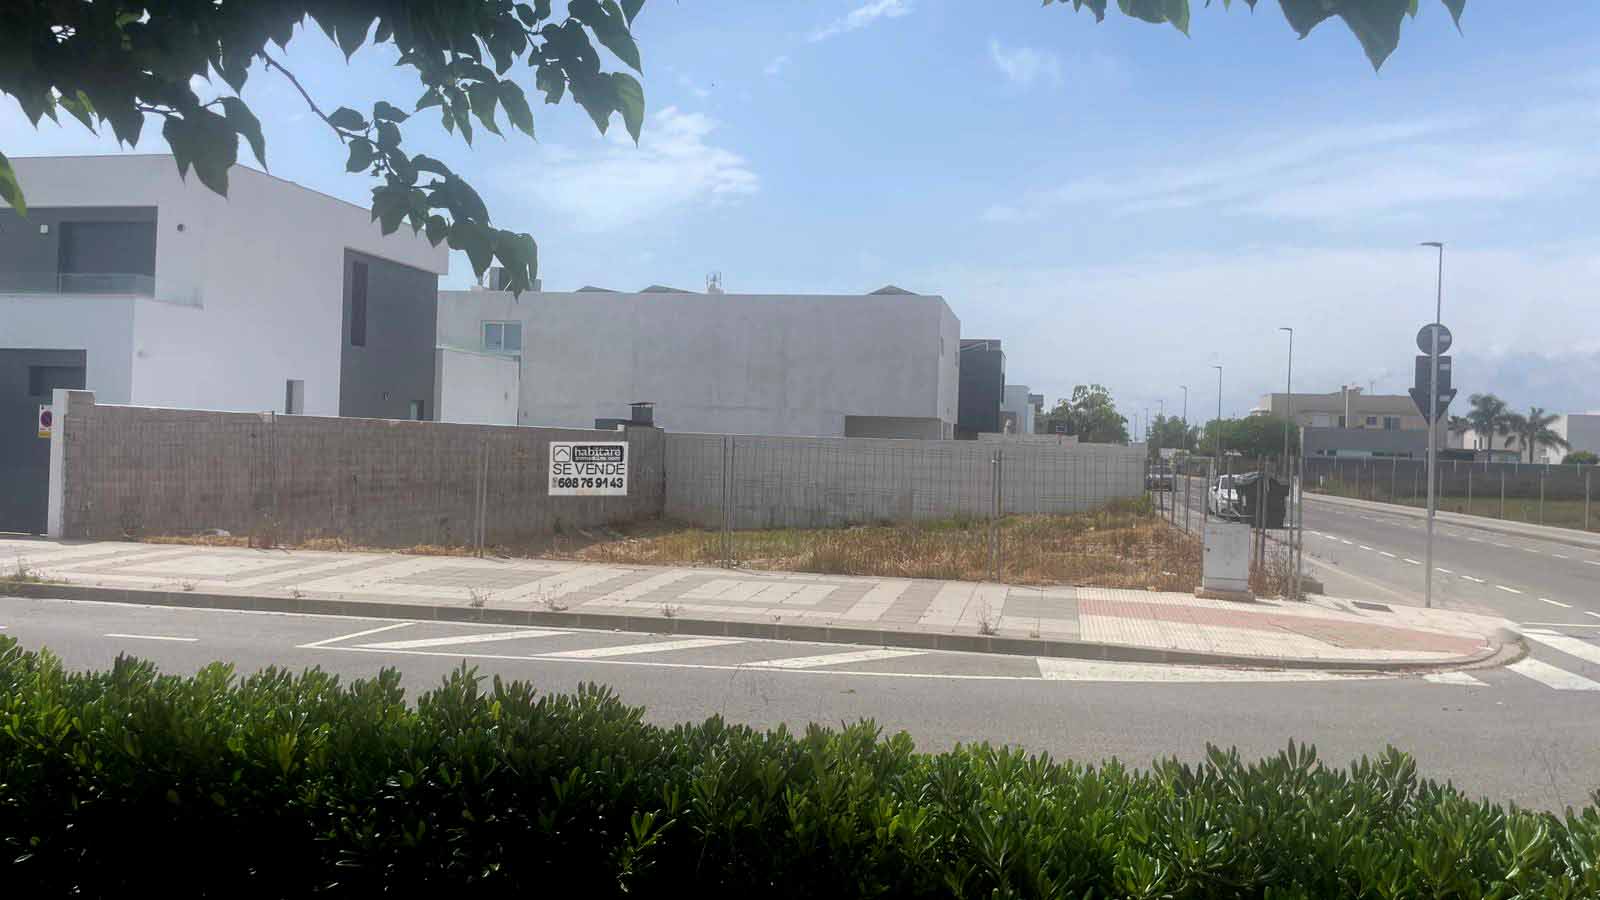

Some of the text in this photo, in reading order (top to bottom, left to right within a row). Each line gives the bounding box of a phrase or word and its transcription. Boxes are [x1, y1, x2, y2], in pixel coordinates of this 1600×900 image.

[575, 446, 621, 457] habitare
[552, 463, 625, 475] SE VENDE
[558, 477, 624, 488] 608 76 91 43
